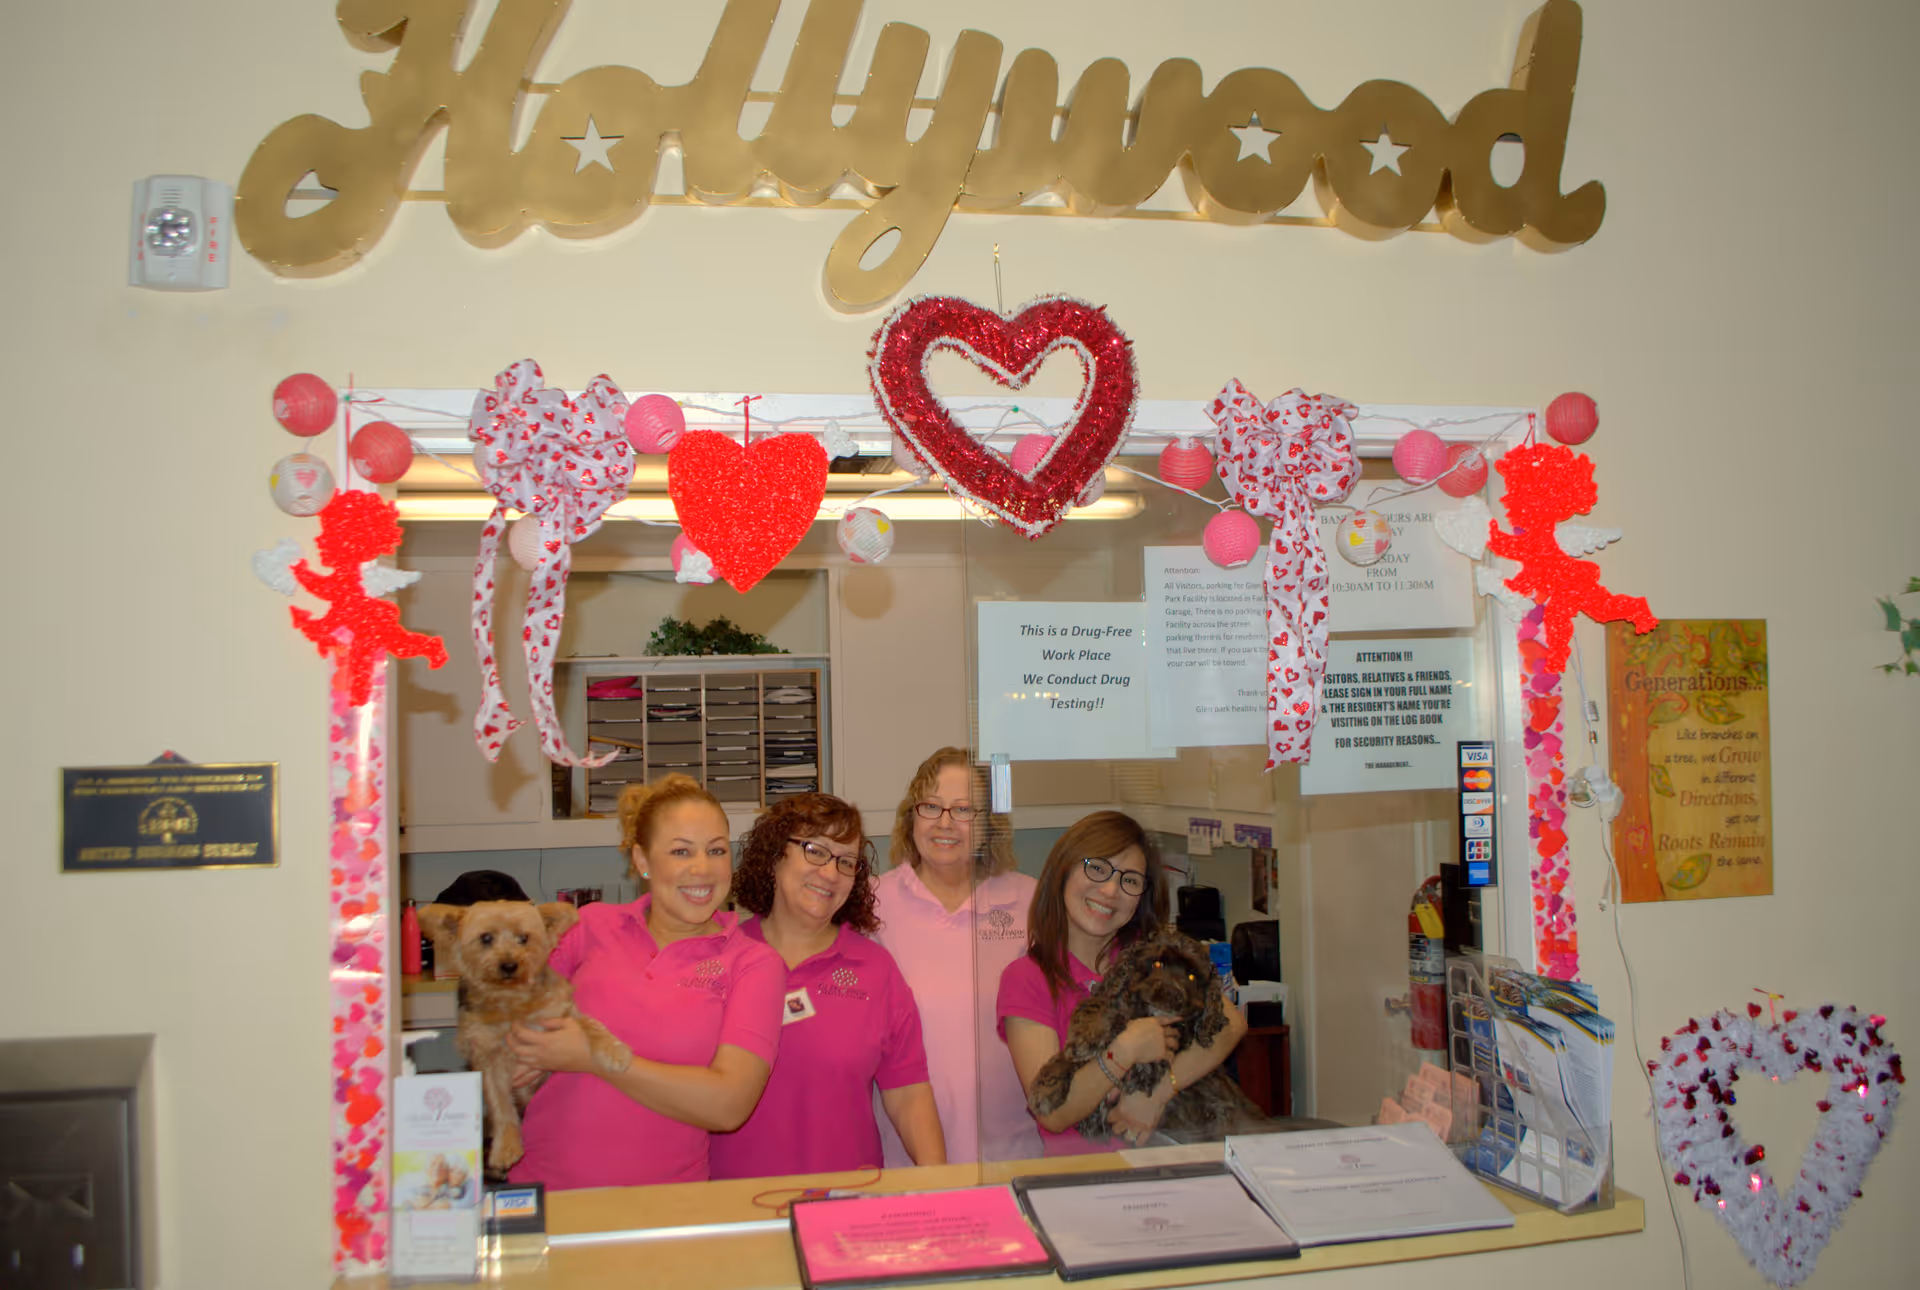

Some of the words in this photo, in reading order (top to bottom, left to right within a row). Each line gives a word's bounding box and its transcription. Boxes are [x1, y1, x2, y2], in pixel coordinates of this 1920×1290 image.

[235, 0, 1606, 312] Hollywood
[1164, 567, 1201, 575] Attention:
[1366, 568, 1398, 578] FROM
[1164, 582, 1174, 590] All
[1206, 582, 1232, 591] parking
[1332, 582, 1374, 592] 10:30AM
[1376, 582, 1392, 591] TO
[1164, 595, 1180, 603] Park
[1182, 594, 1208, 604] Facility
[1216, 594, 1242, 602] located
[1195, 608, 1216, 616] There
[1235, 608, 1262, 617] parking
[1166, 621, 1191, 630] Facility
[1020, 624, 1044, 638] This
[1048, 624, 1058, 638] is
[1060, 628, 1069, 638] a
[1071, 625, 1132, 640] Drug-Free
[1166, 634, 1194, 643] parking
[1222, 632, 1233, 641] for
[1042, 649, 1076, 662] Work
[1078, 649, 1112, 662] Place
[1166, 646, 1182, 655] that
[1183, 646, 1196, 654] live
[1356, 651, 1402, 663] ATTENTION
[1404, 651, 1413, 662] !!!
[1166, 660, 1184, 668] your
[1184, 660, 1198, 668] car
[1198, 659, 1211, 667] will
[1222, 659, 1248, 668] towed.
[1022, 674, 1044, 686] We
[1046, 673, 1098, 686] Conduct
[1100, 673, 1131, 688] Drug
[1323, 672, 1360, 684] ISITORS,
[1362, 672, 1406, 683] RELATIVES
[1407, 672, 1414, 682] &
[1625, 670, 1763, 692] Generations...
[1237, 689, 1260, 697] Thank
[1350, 687, 1372, 698] SIGN
[1373, 687, 1382, 697] IN
[1384, 686, 1407, 697] YOUR
[1408, 685, 1428, 696] FULL
[1429, 684, 1452, 696] NAME
[1050, 698, 1105, 712] Testing!!
[1196, 705, 1213, 713] Glen
[1214, 705, 1231, 714] park
[1232, 704, 1258, 714] healthy
[1321, 704, 1328, 714] &
[1329, 702, 1346, 714] THE
[1348, 700, 1396, 713] RESIDENT'S
[1396, 700, 1421, 711] NAME
[1421, 699, 1452, 710] YOU'RE
[1330, 716, 1369, 728] VISITING
[1370, 716, 1382, 727] ON
[1384, 715, 1400, 726] THE
[1402, 714, 1418, 726] LOG
[1419, 714, 1444, 724] BOOK
[1677, 728, 1697, 740] Like
[1700, 728, 1743, 740] branches
[1744, 730, 1759, 740] on
[1335, 738, 1352, 749] FOR
[1353, 736, 1394, 748] SECURITY
[1466, 752, 1488, 760] VISA
[1702, 755, 1716, 764] we
[1718, 746, 1761, 765] Grow
[1714, 771, 1756, 784] different
[1744, 814, 1761, 824] our
[1658, 832, 1703, 851] Roots
[1710, 832, 1766, 850] Remain
[503, 1198, 529, 1209] VISA
